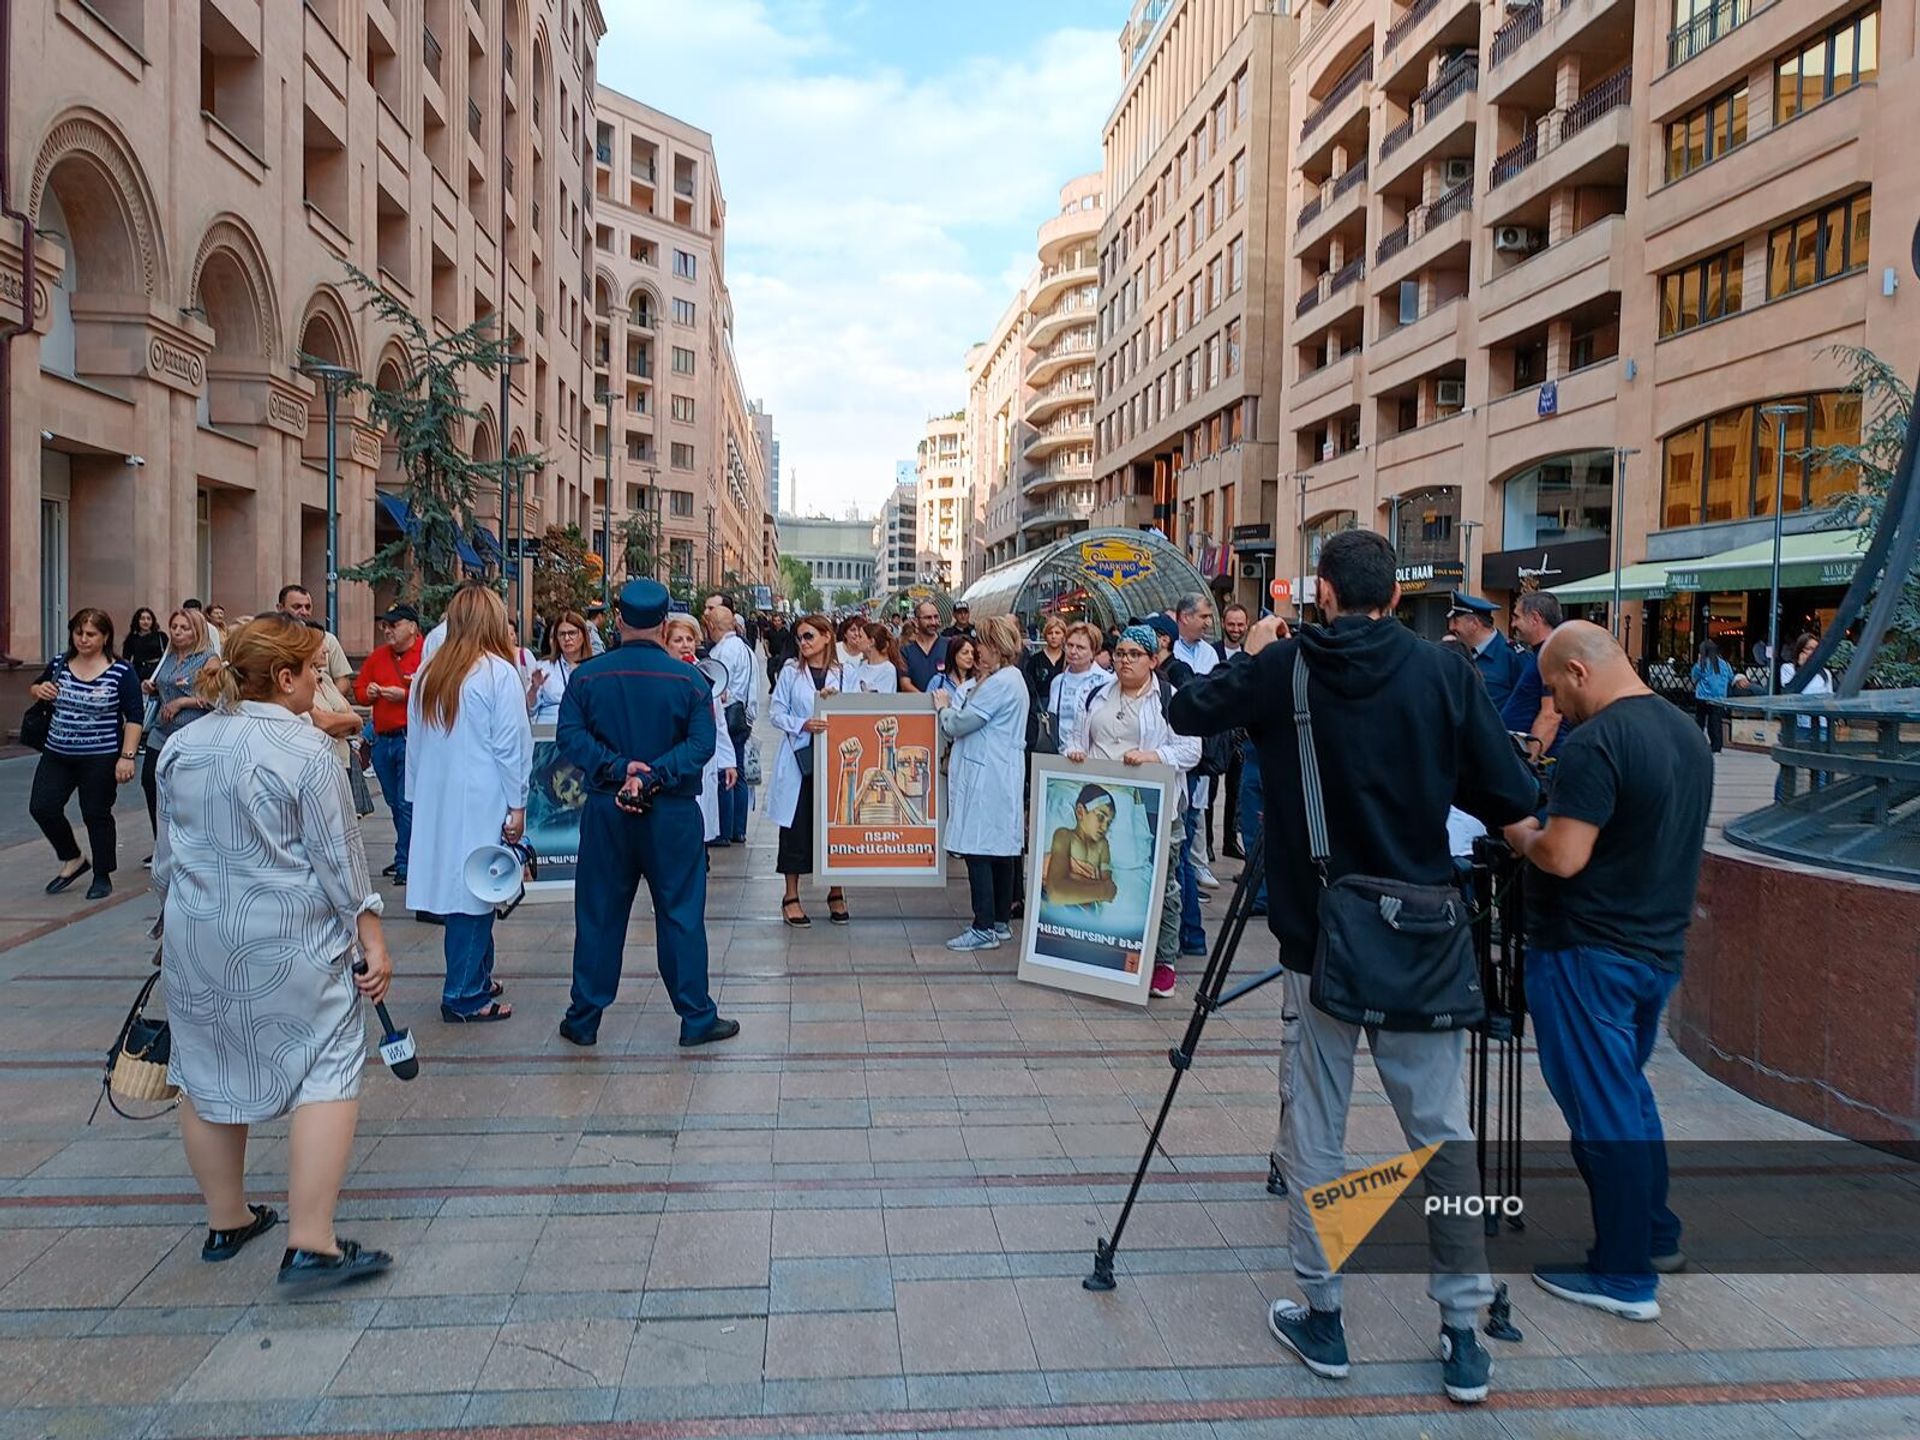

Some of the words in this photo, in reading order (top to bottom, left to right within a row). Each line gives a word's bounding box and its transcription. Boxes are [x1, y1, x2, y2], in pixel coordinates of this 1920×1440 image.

[1099, 562, 1136, 571] PARKING
[1396, 567, 1411, 581] OLE
[1412, 564, 1433, 580] HAAN
